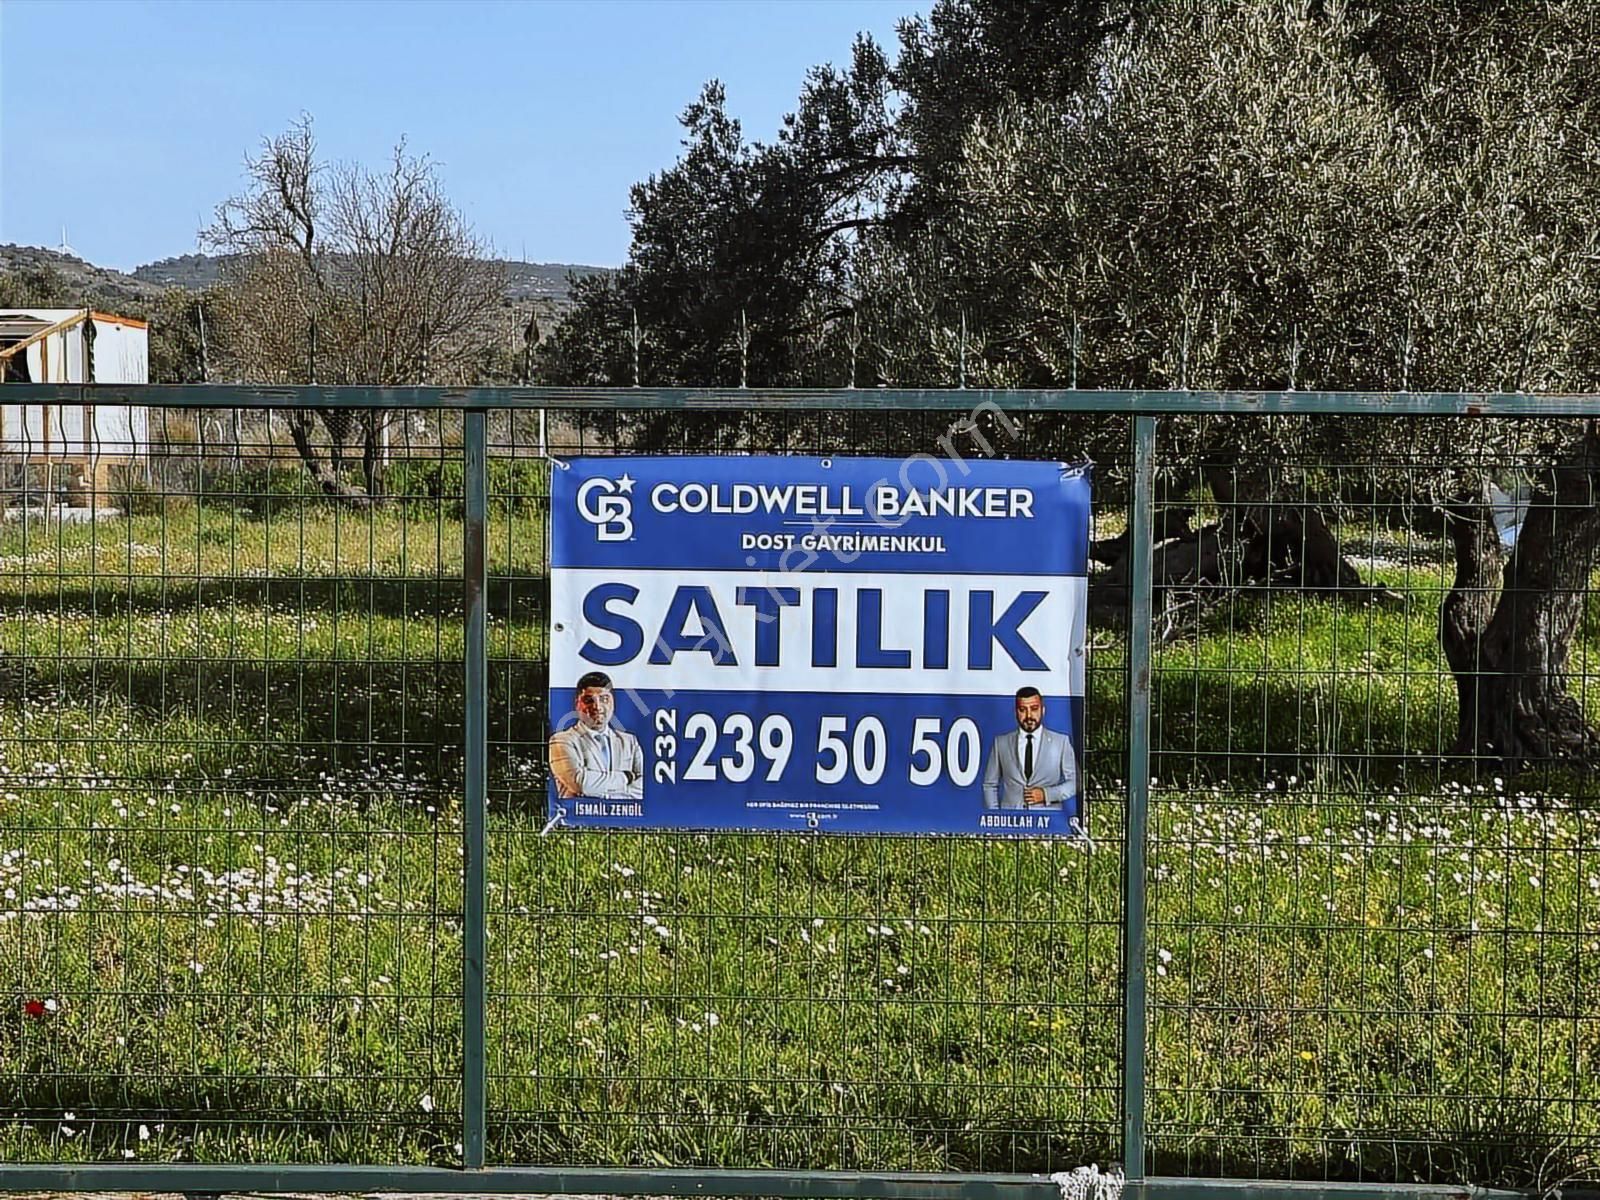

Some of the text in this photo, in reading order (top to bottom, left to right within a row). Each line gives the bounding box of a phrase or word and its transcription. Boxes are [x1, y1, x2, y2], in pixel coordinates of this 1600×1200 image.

[651, 483, 1034, 519] COLDWELL BANKER
[741, 530, 947, 555] DOST GAYRİMENKUL
[579, 582, 1050, 672] SATILIK
[654, 708, 677, 785] 232
[683, 713, 982, 788] 239 50 50
[575, 801, 609, 816] İSMAİL
[979, 814, 1051, 829] ABDULLAH AY
